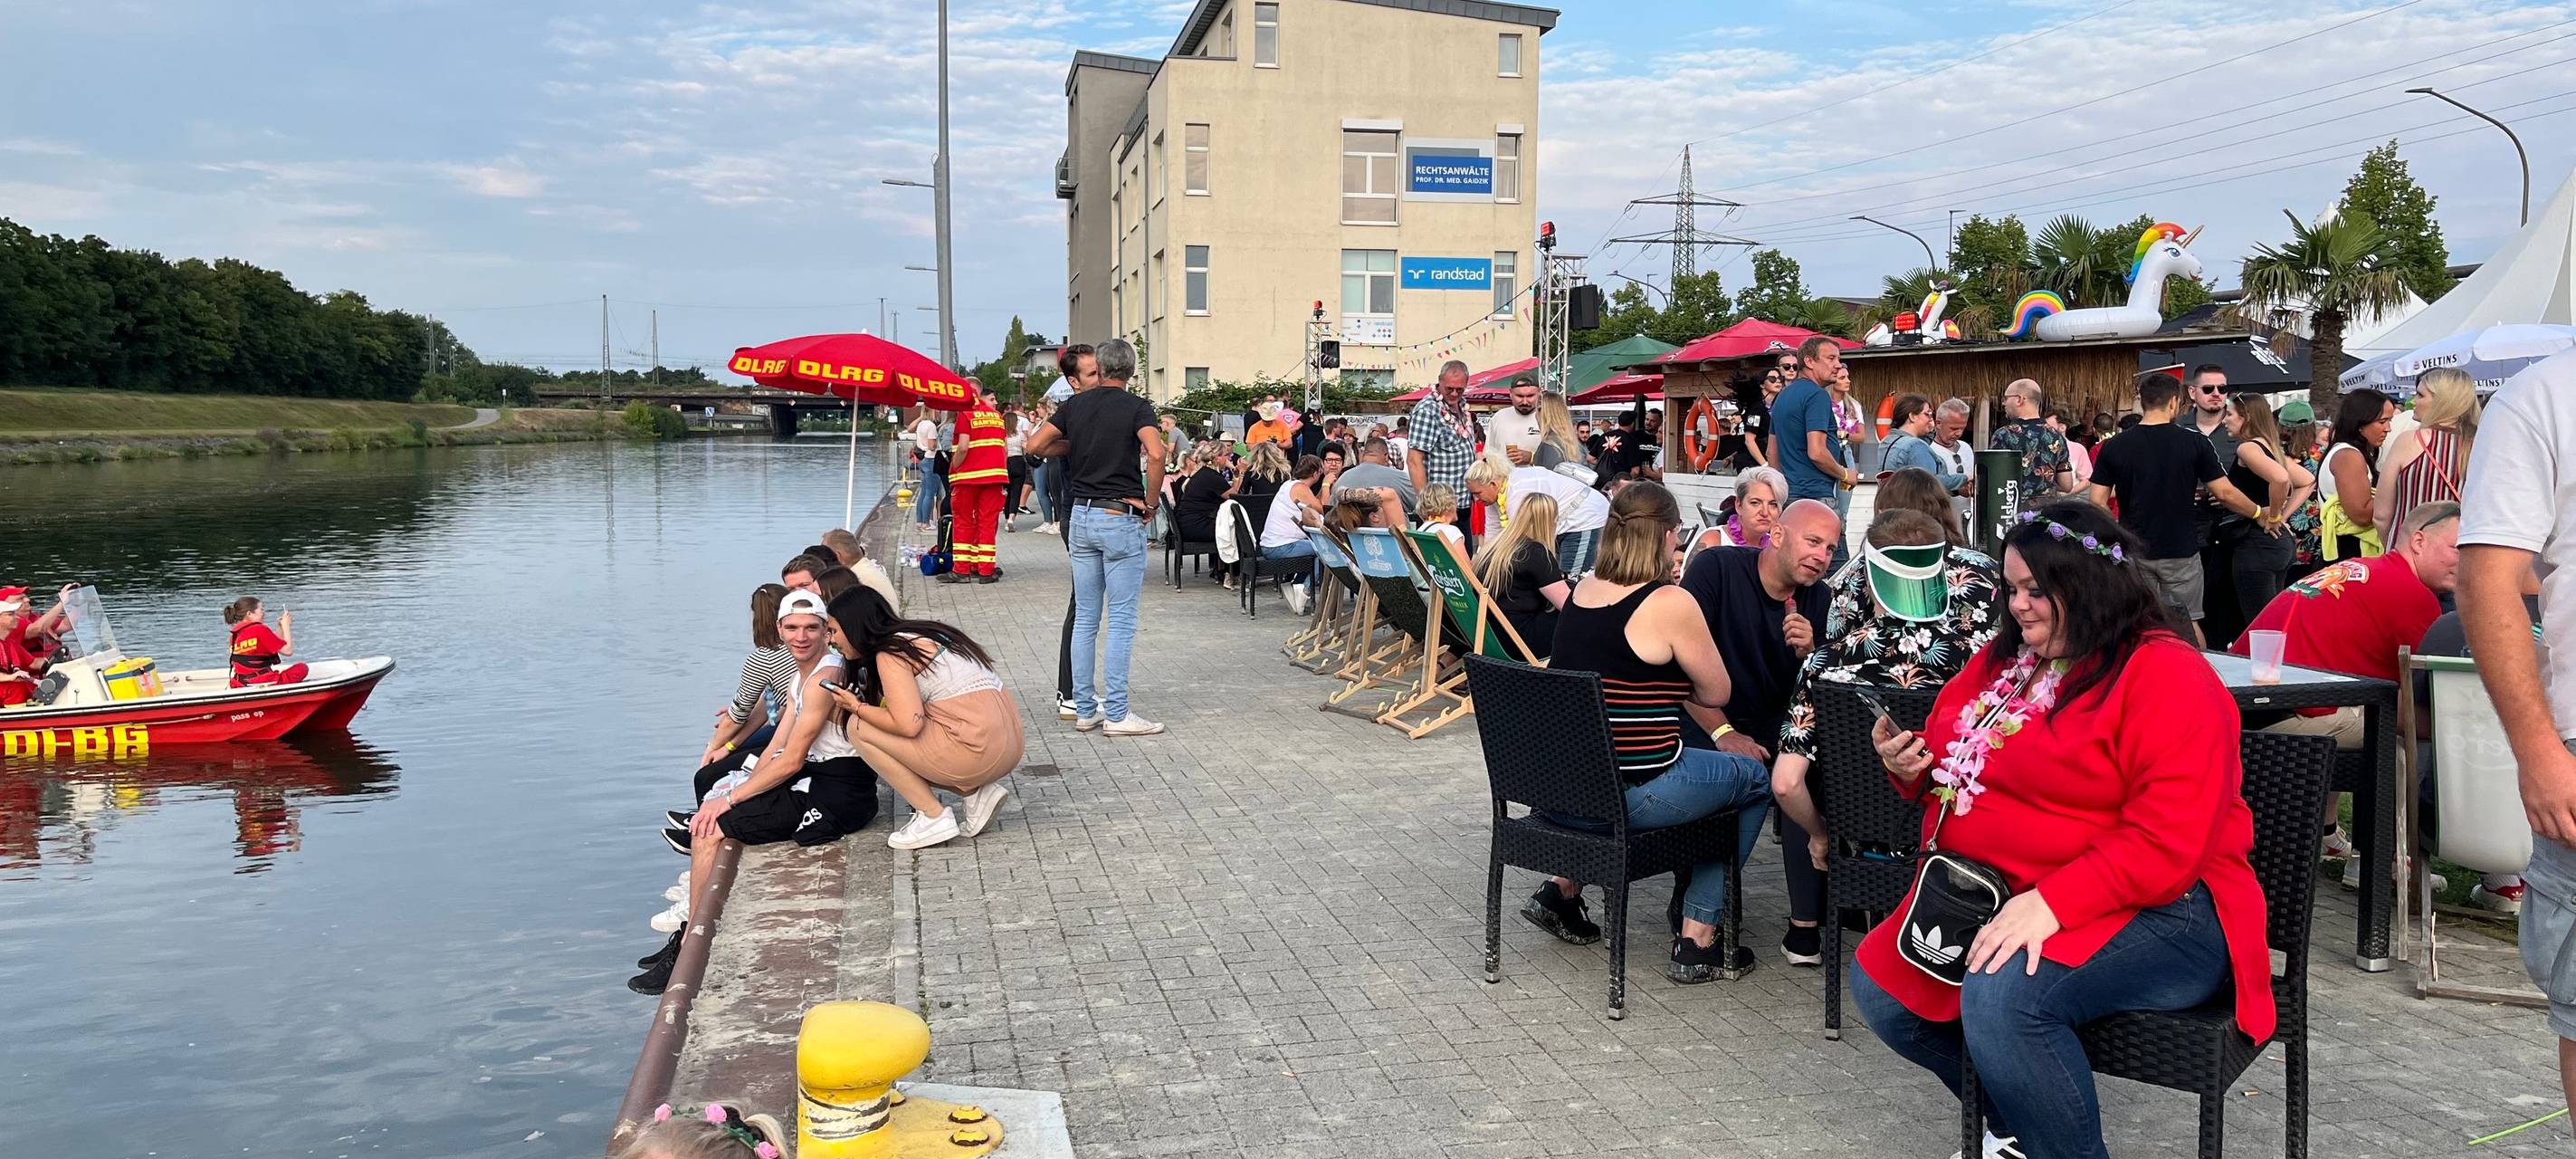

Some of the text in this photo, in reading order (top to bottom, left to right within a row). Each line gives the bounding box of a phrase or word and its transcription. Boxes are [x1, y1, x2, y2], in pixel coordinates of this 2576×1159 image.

[1416, 166, 1490, 176] RECHTSANWÄLTE
[1431, 266, 1484, 281] randstad
[734, 357, 787, 373] DLRG
[2421, 354, 2457, 369] VELTINS
[797, 359, 884, 383] DLRG
[898, 372, 965, 398] DLRG
[2344, 374, 2367, 387] VELTIN
[1997, 480, 2019, 541] rlsberg
[1428, 564, 1465, 597] Carlsberg
